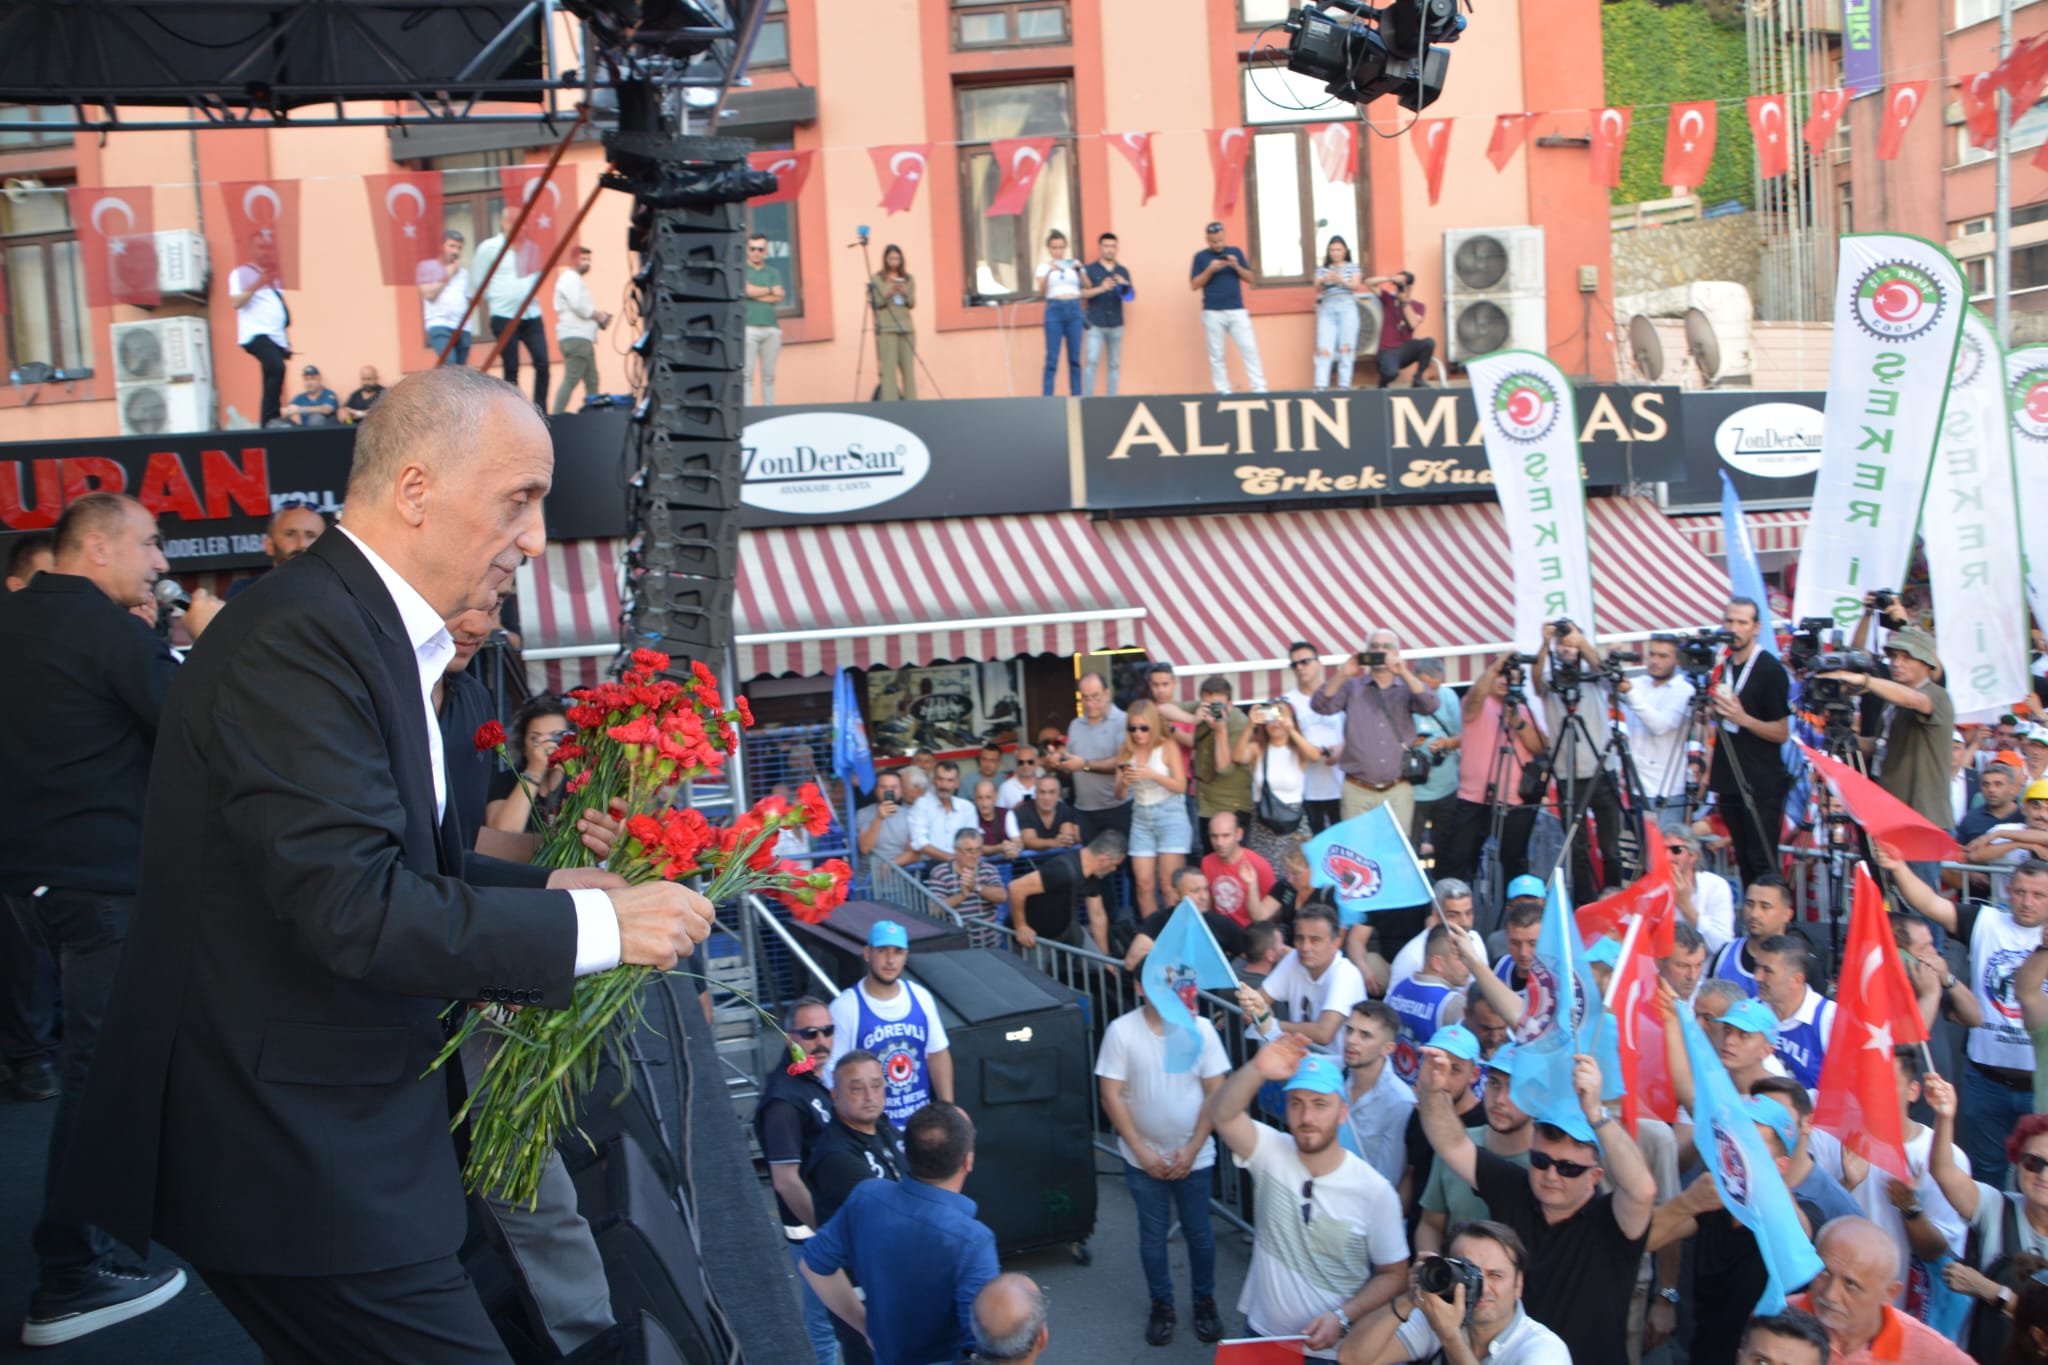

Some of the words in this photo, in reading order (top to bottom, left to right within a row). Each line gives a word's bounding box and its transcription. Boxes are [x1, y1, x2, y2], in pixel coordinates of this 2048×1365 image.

[1106, 398, 1351, 459] ALTIN
[1389, 391, 1669, 448] MAS
[1234, 465, 1387, 495] Erkek
[863, 1023, 925, 1049] GÖREVLİ
